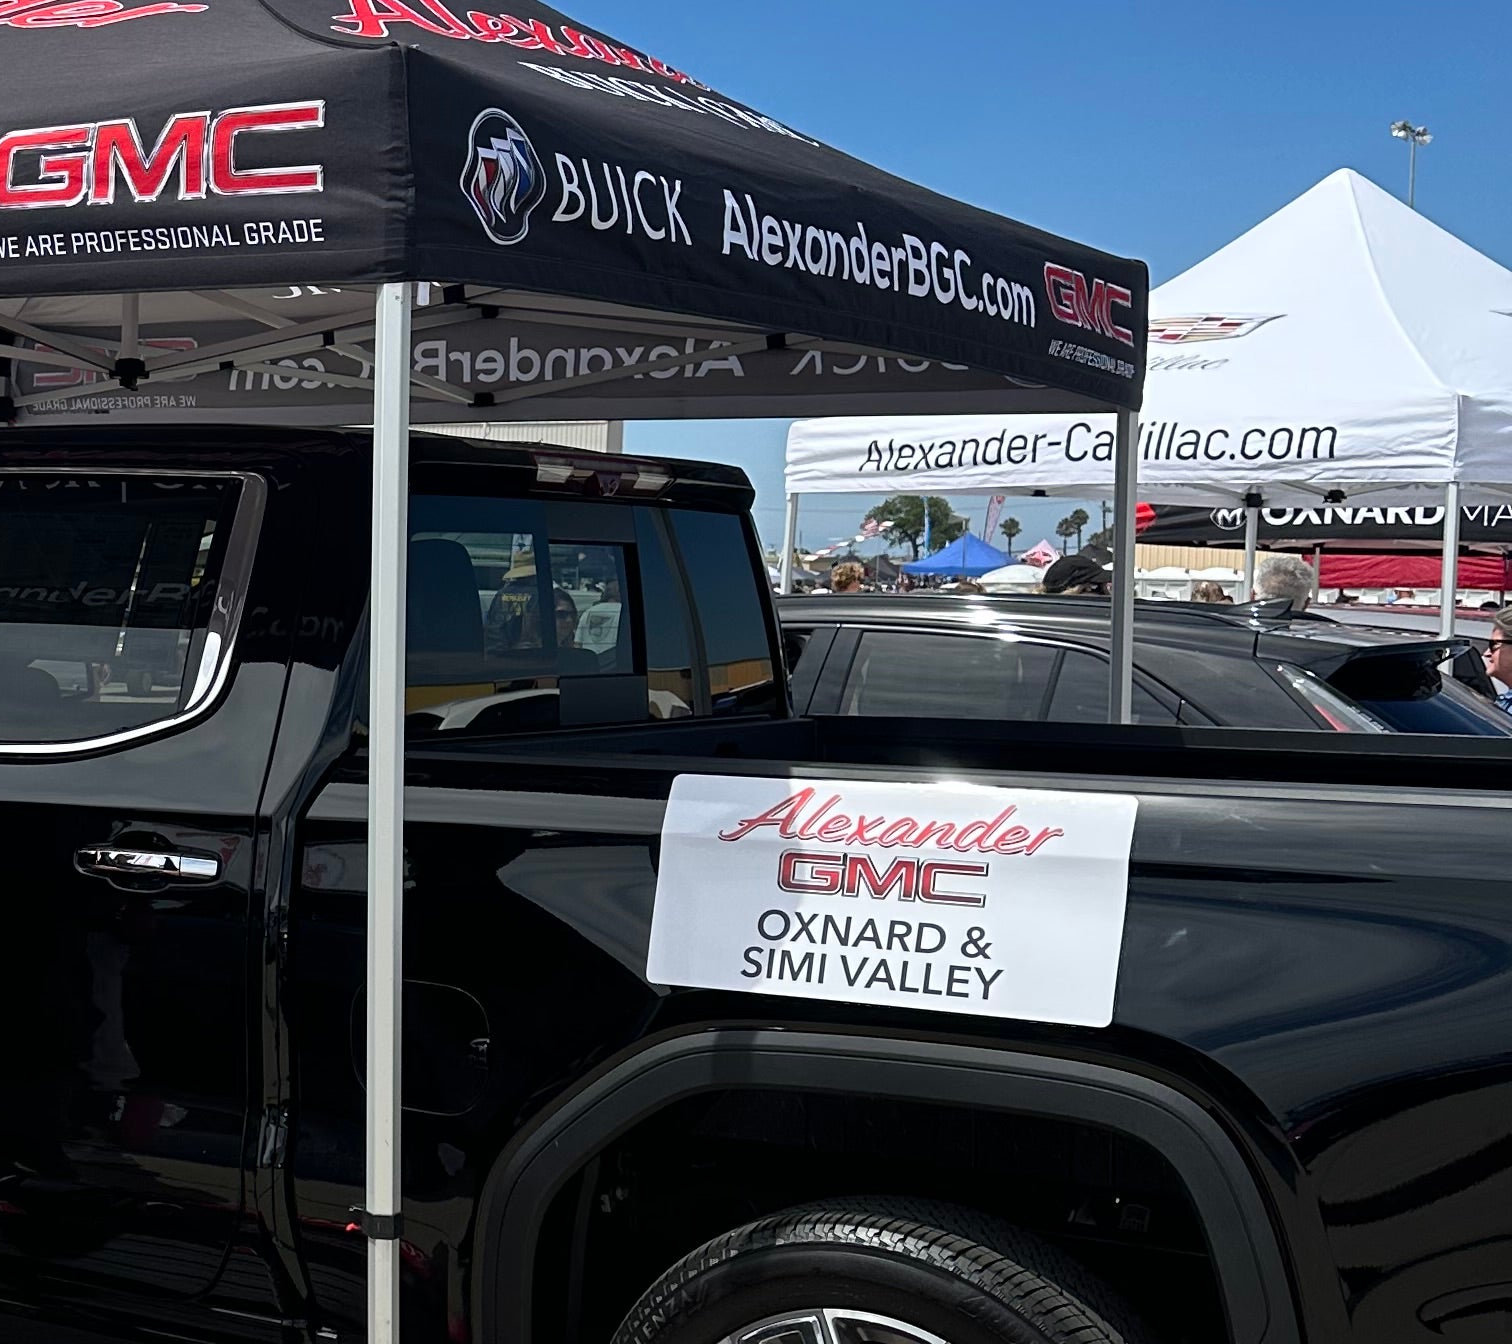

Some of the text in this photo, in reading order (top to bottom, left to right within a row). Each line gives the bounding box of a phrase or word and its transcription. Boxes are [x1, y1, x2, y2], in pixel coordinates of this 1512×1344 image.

[24, 233, 67, 257] ARE
[71, 224, 241, 254] PROFESSIONAL
[243, 218, 325, 245] GRADE
[551, 152, 1036, 329] BUICK AlexanderBGC.com
[1044, 261, 1135, 348] GMC
[858, 420, 1338, 473] Alexander-Caillac.com
[1462, 505, 1512, 528] MA
[717, 786, 1065, 856] Alexander
[776, 849, 990, 908] GMC
[756, 908, 994, 960] OXNARD &
[740, 946, 1005, 1002] SIMI VALLEY
